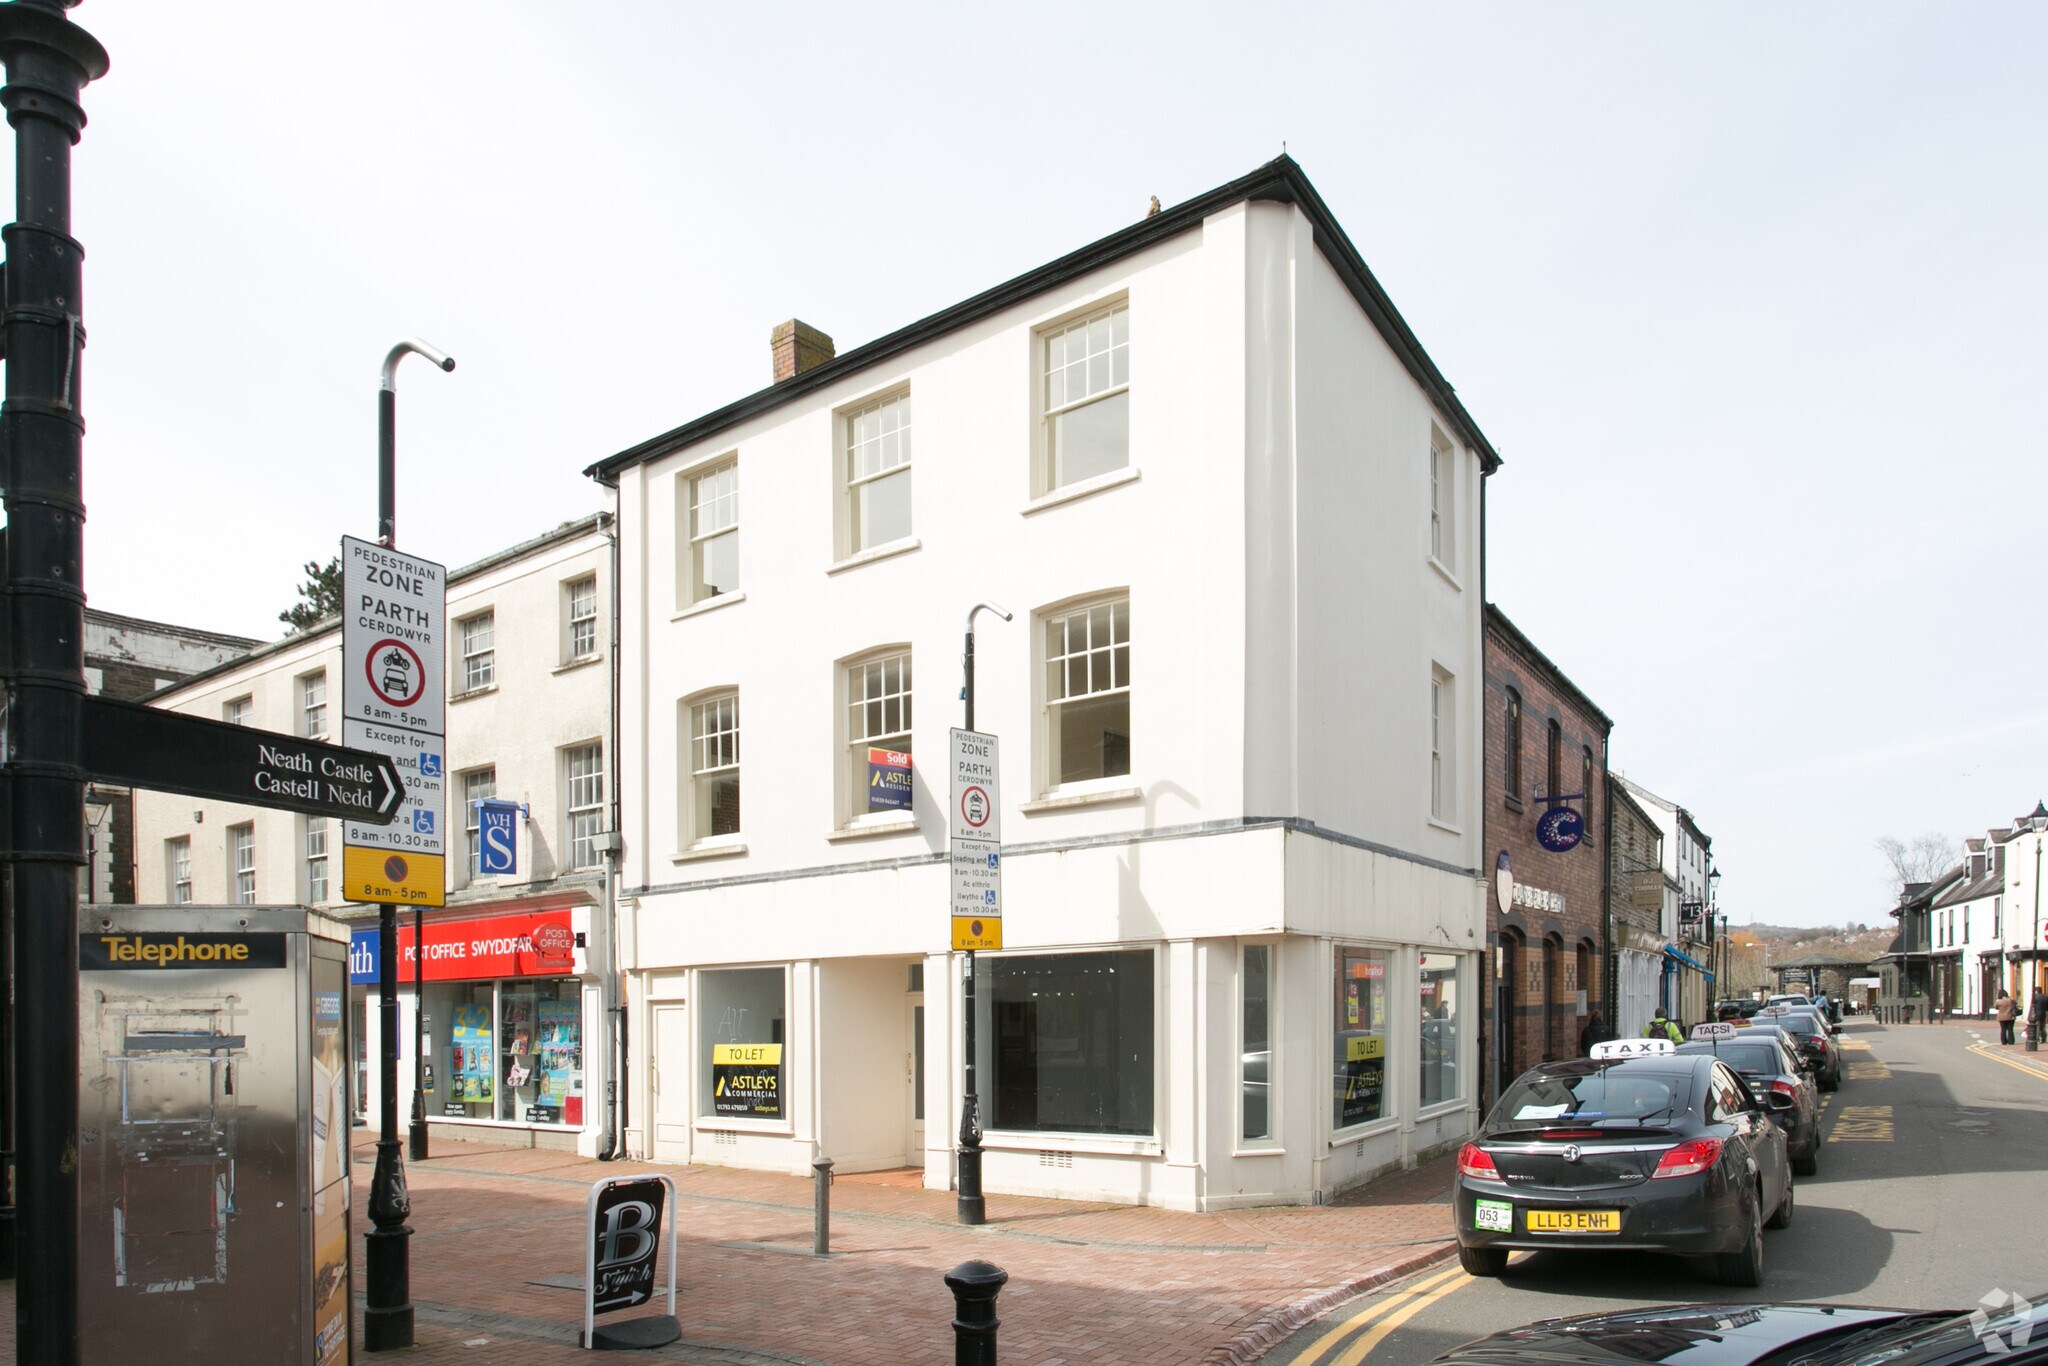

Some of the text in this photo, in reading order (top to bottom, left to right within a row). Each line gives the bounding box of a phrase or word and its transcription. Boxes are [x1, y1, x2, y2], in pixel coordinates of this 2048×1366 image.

[354, 547, 436, 580] PEDESTRIAN
[366, 565, 424, 596] ZONE
[362, 594, 429, 628] PARTH
[359, 616, 430, 644] CERDDWYR
[364, 705, 372, 716] 8
[374, 708, 391, 719] am
[401, 712, 408, 723] 5
[410, 715, 427, 726] pm
[366, 728, 426, 748] Except for
[956, 732, 994, 746] PEDESTRIAN
[962, 743, 988, 757] ZONE
[258, 744, 313, 774] Neath
[320, 758, 373, 784] Castle
[396, 756, 416, 768] and
[887, 752, 907, 764] Sold
[959, 762, 992, 776] PARTH
[886, 772, 912, 785] ASTLE
[958, 775, 992, 785] CERDDWYR
[255, 771, 373, 808] Castell Nedd
[424, 782, 439, 790] am
[886, 783, 910, 791] RESIDEN
[486, 812, 510, 826] WH
[352, 829, 358, 839] 8
[362, 832, 378, 842] am
[388, 834, 421, 846] 10.30
[424, 838, 439, 848] am
[486, 826, 512, 870] S
[954, 855, 974, 864] loading
[365, 885, 371, 895] 8
[375, 886, 391, 896] am
[401, 888, 408, 898] 5
[411, 889, 427, 900] pm
[1690, 906, 1702, 918] 13
[546, 929, 567, 938] POST
[430, 942, 465, 958] OFFICE
[540, 939, 570, 948] OFFICE
[101, 936, 248, 966] Telephone
[350, 941, 373, 974] ith
[454, 1008, 466, 1036] 3
[477, 1006, 490, 1036] 2
[1698, 1024, 1730, 1035] TACSI
[730, 1049, 764, 1060] TO LET
[1357, 1041, 1377, 1055] TO LET
[1600, 1043, 1665, 1053] TAXI
[732, 1076, 776, 1090] ASTLEYS
[1358, 1070, 1383, 1088] ASTLEYS
[1480, 1209, 1498, 1222] 053
[1537, 1214, 1609, 1228] LL13 ENH
[597, 1201, 656, 1270] B
